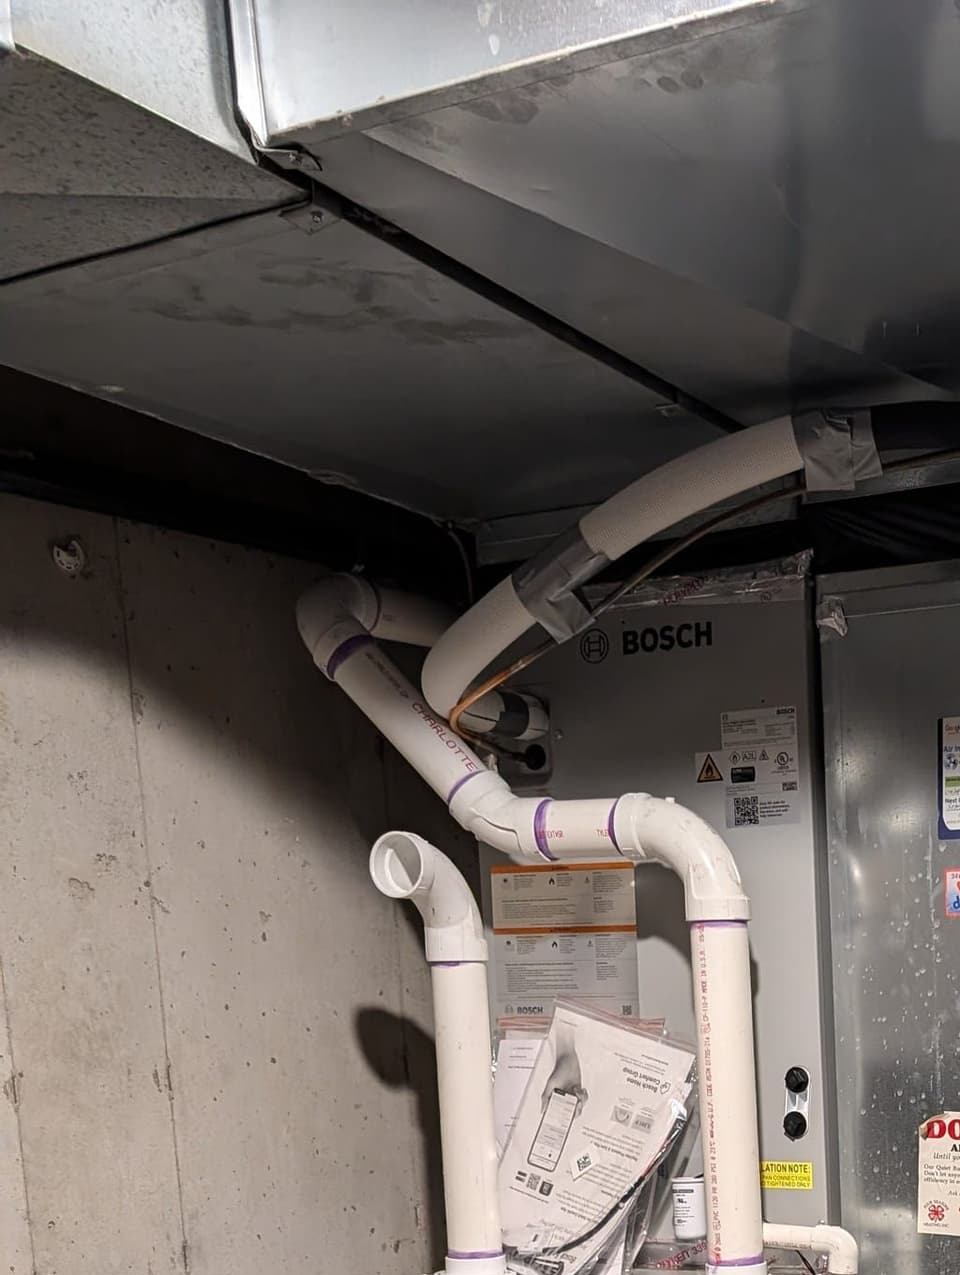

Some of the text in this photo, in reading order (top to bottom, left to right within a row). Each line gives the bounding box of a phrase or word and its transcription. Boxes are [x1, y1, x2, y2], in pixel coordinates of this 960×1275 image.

[622, 621, 713, 656] BOSCH
[412, 702, 478, 772] CHARLOTTE
[517, 1005, 543, 1015] BOSCH
[933, 1152, 951, 1160] Until
[789, 1163, 811, 1174] NOTE:
